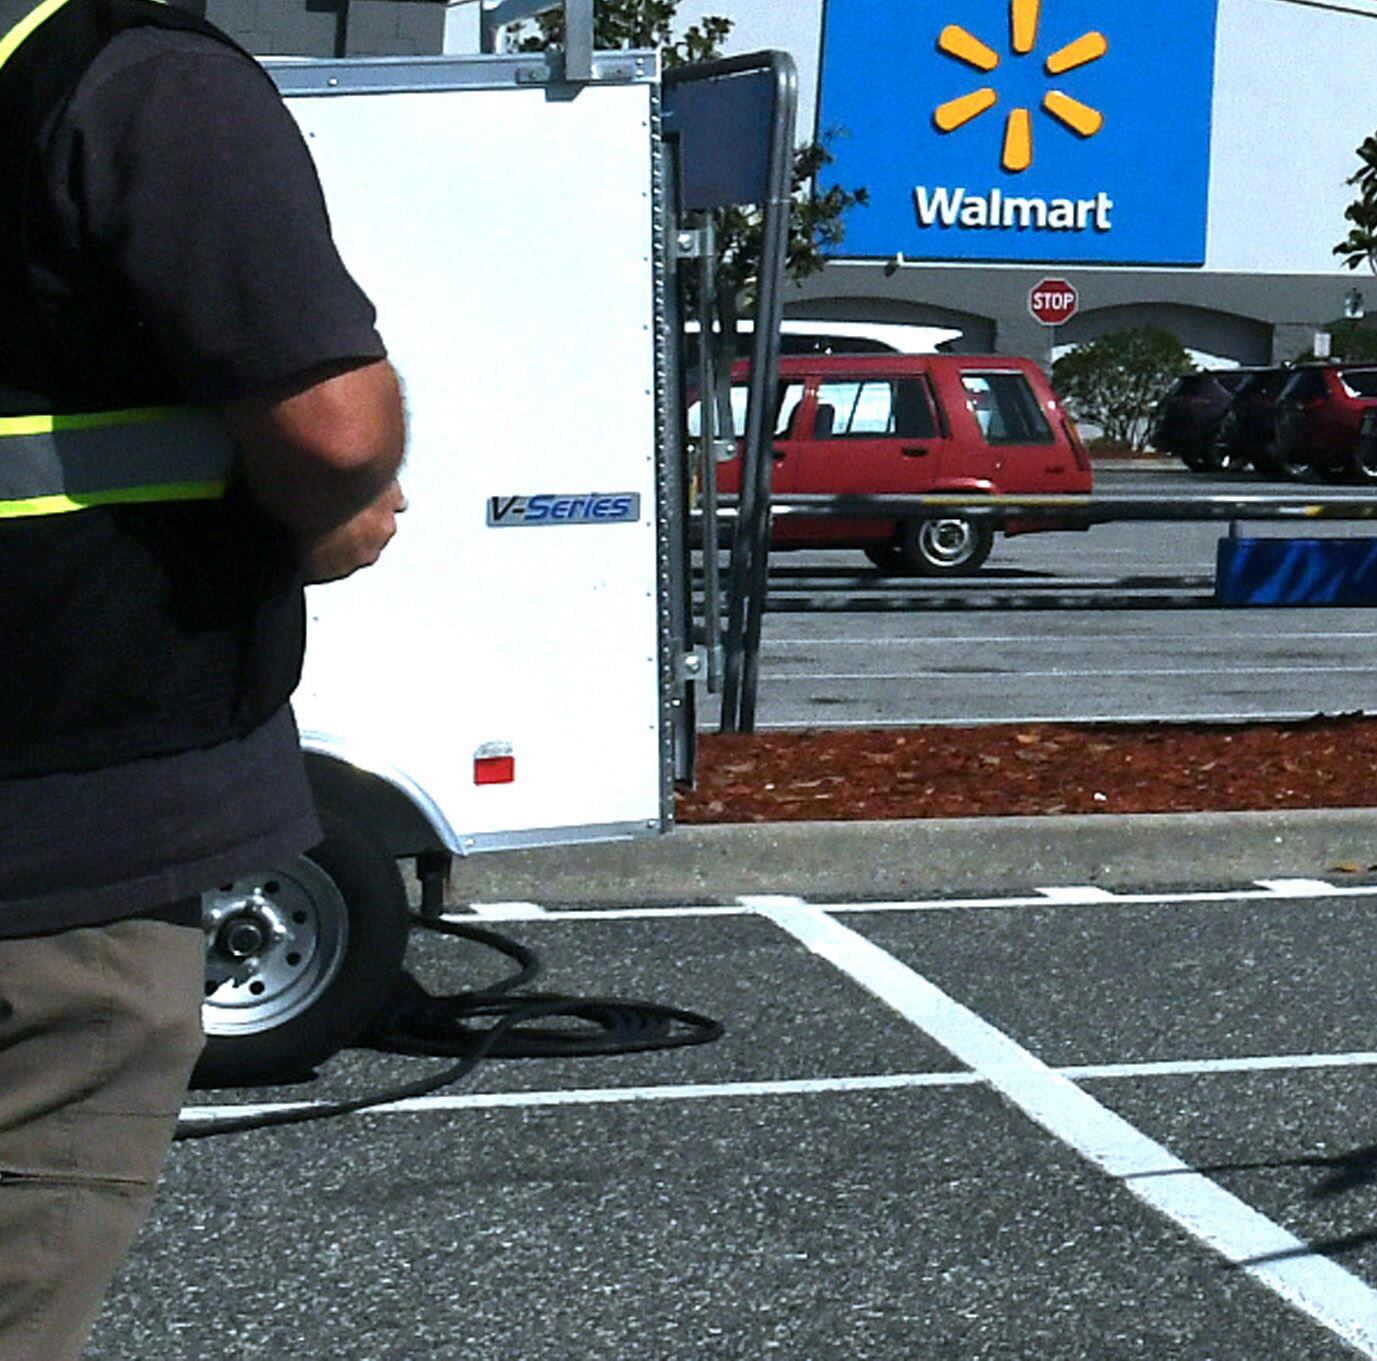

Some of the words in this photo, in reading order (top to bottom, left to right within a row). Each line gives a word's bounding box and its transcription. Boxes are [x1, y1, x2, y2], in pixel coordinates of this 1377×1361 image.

[914, 185, 1113, 230] Walmart
[1033, 292, 1075, 310] STOP
[492, 493, 632, 521] V-Series
